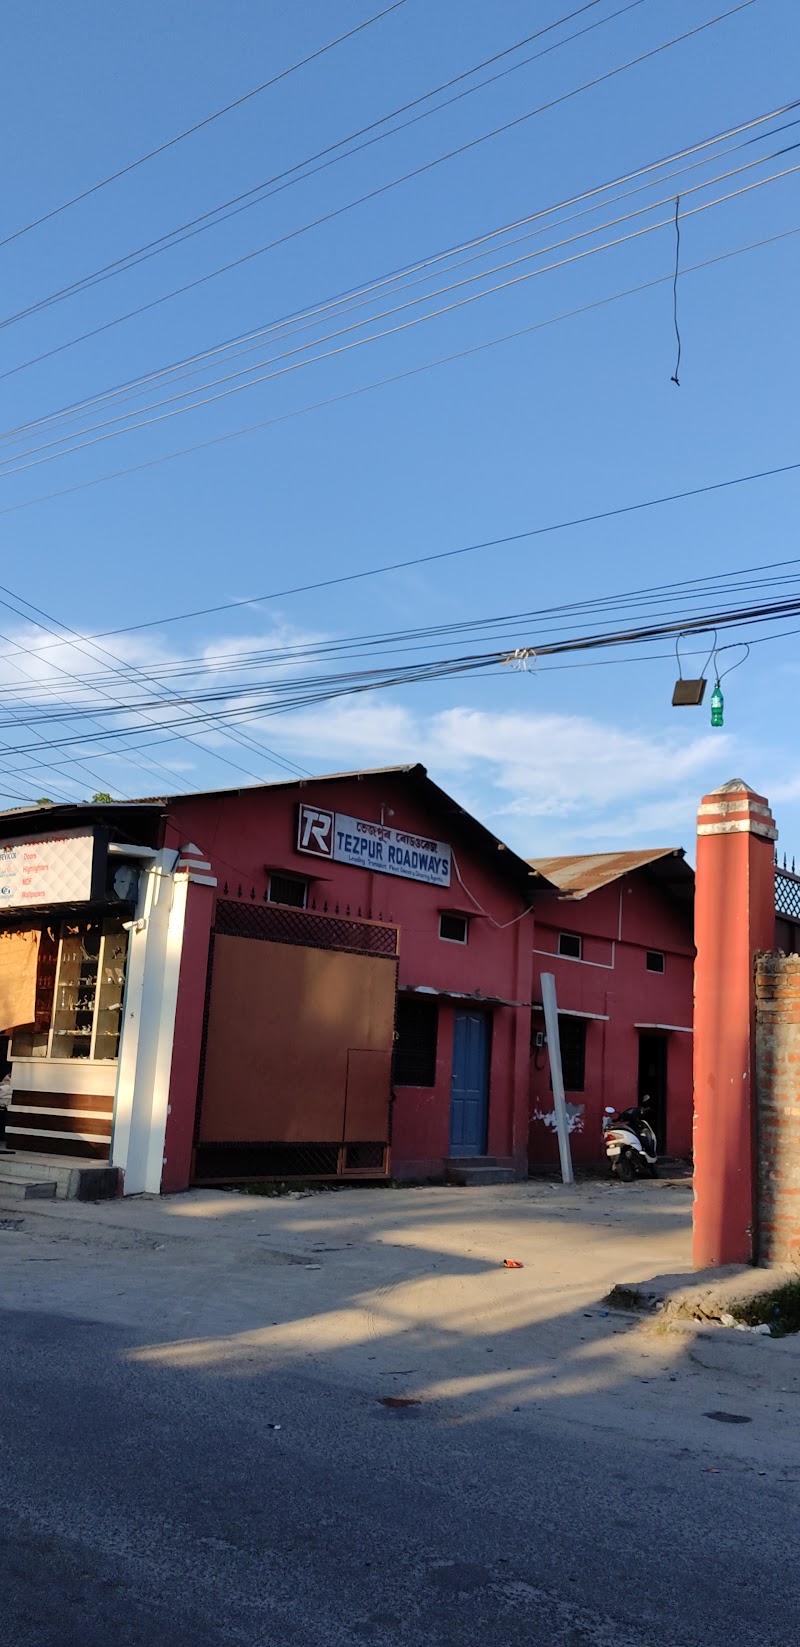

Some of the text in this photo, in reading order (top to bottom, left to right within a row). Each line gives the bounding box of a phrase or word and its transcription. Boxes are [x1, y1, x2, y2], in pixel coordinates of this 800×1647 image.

[302, 810, 331, 852] TR
[337, 832, 448, 876] TEZPUR ROADWAYS
[349, 855, 365, 866] Leading
[368, 859, 387, 870] Transport
[23, 864, 49, 874] Highlighters
[22, 878, 32, 886] MDF
[22, 891, 46, 899] Wallpapers
